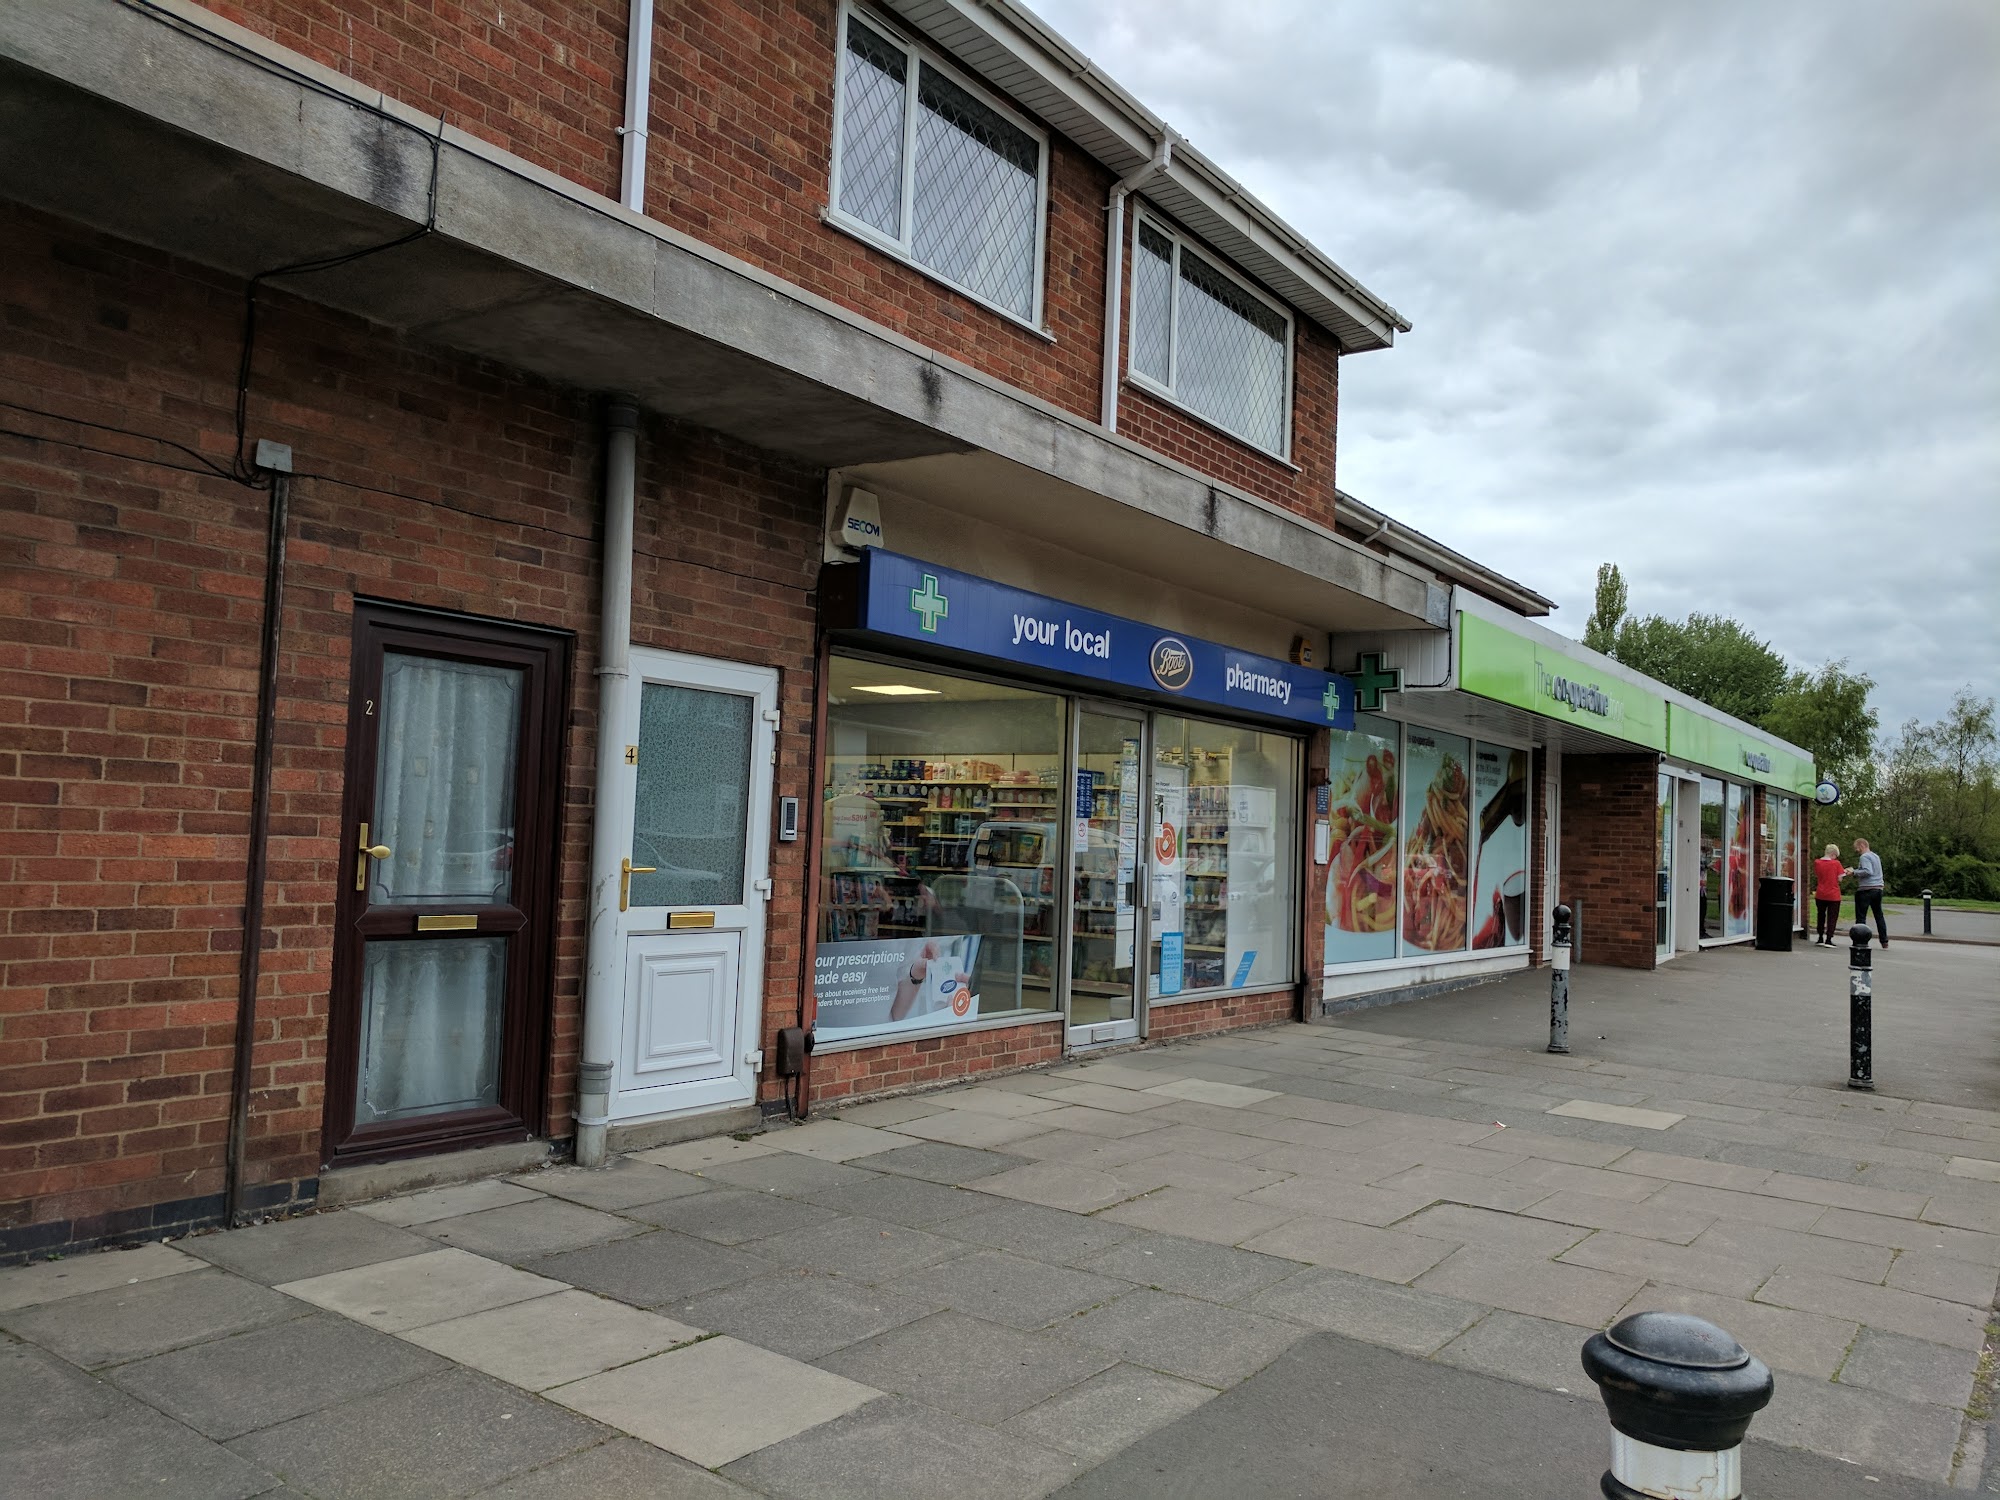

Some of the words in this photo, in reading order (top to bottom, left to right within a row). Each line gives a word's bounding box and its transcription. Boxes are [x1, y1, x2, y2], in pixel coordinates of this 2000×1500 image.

[848, 517, 880, 537] SECOM
[1012, 613, 1060, 647] your
[1064, 619, 1111, 660] local
[1156, 647, 1187, 677] Boots
[1225, 662, 1292, 705] pharmacy
[365, 700, 373, 715] 2
[625, 747, 635, 764] 4
[814, 956, 835, 968] our
[836, 950, 905, 968] prescriptions
[841, 971, 867, 984] easy
[824, 989, 842, 998] about
[816, 999, 833, 1007] nders
[833, 998, 842, 1006] for
